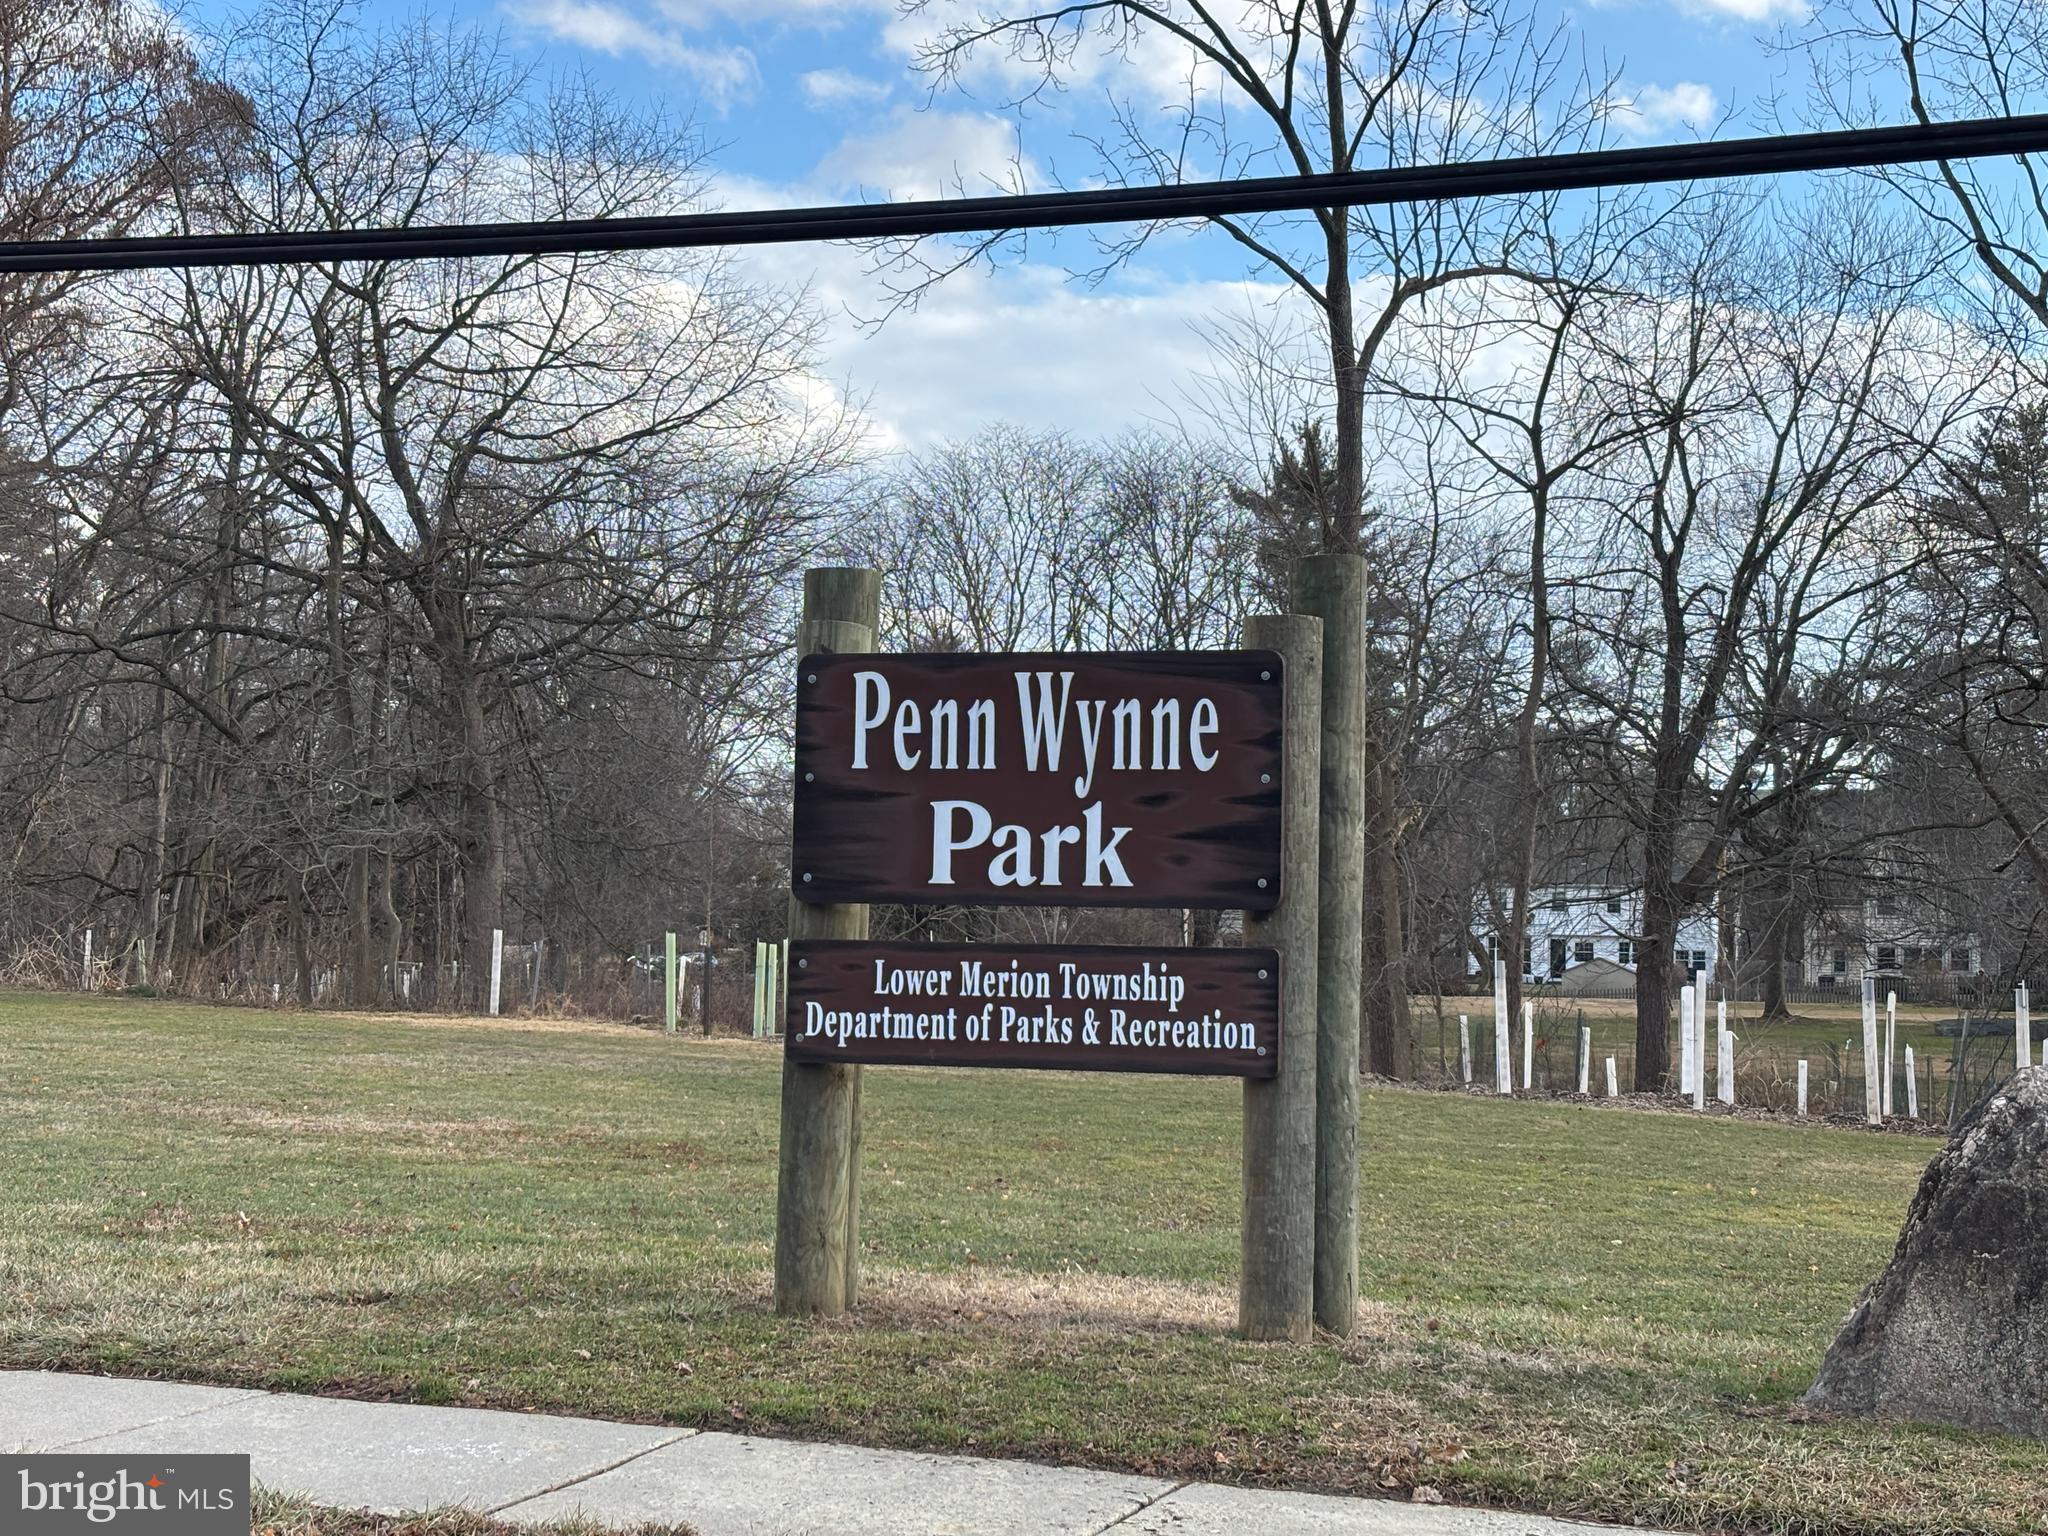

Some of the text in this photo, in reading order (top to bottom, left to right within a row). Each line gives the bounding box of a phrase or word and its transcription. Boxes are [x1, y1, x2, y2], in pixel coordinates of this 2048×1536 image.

[850, 670, 1219, 799] Penn Wynne
[927, 800, 1134, 888] Park
[873, 959, 1186, 1012] Lower Merion Township
[803, 1001, 1257, 1050] Department of Parks & Recreation
